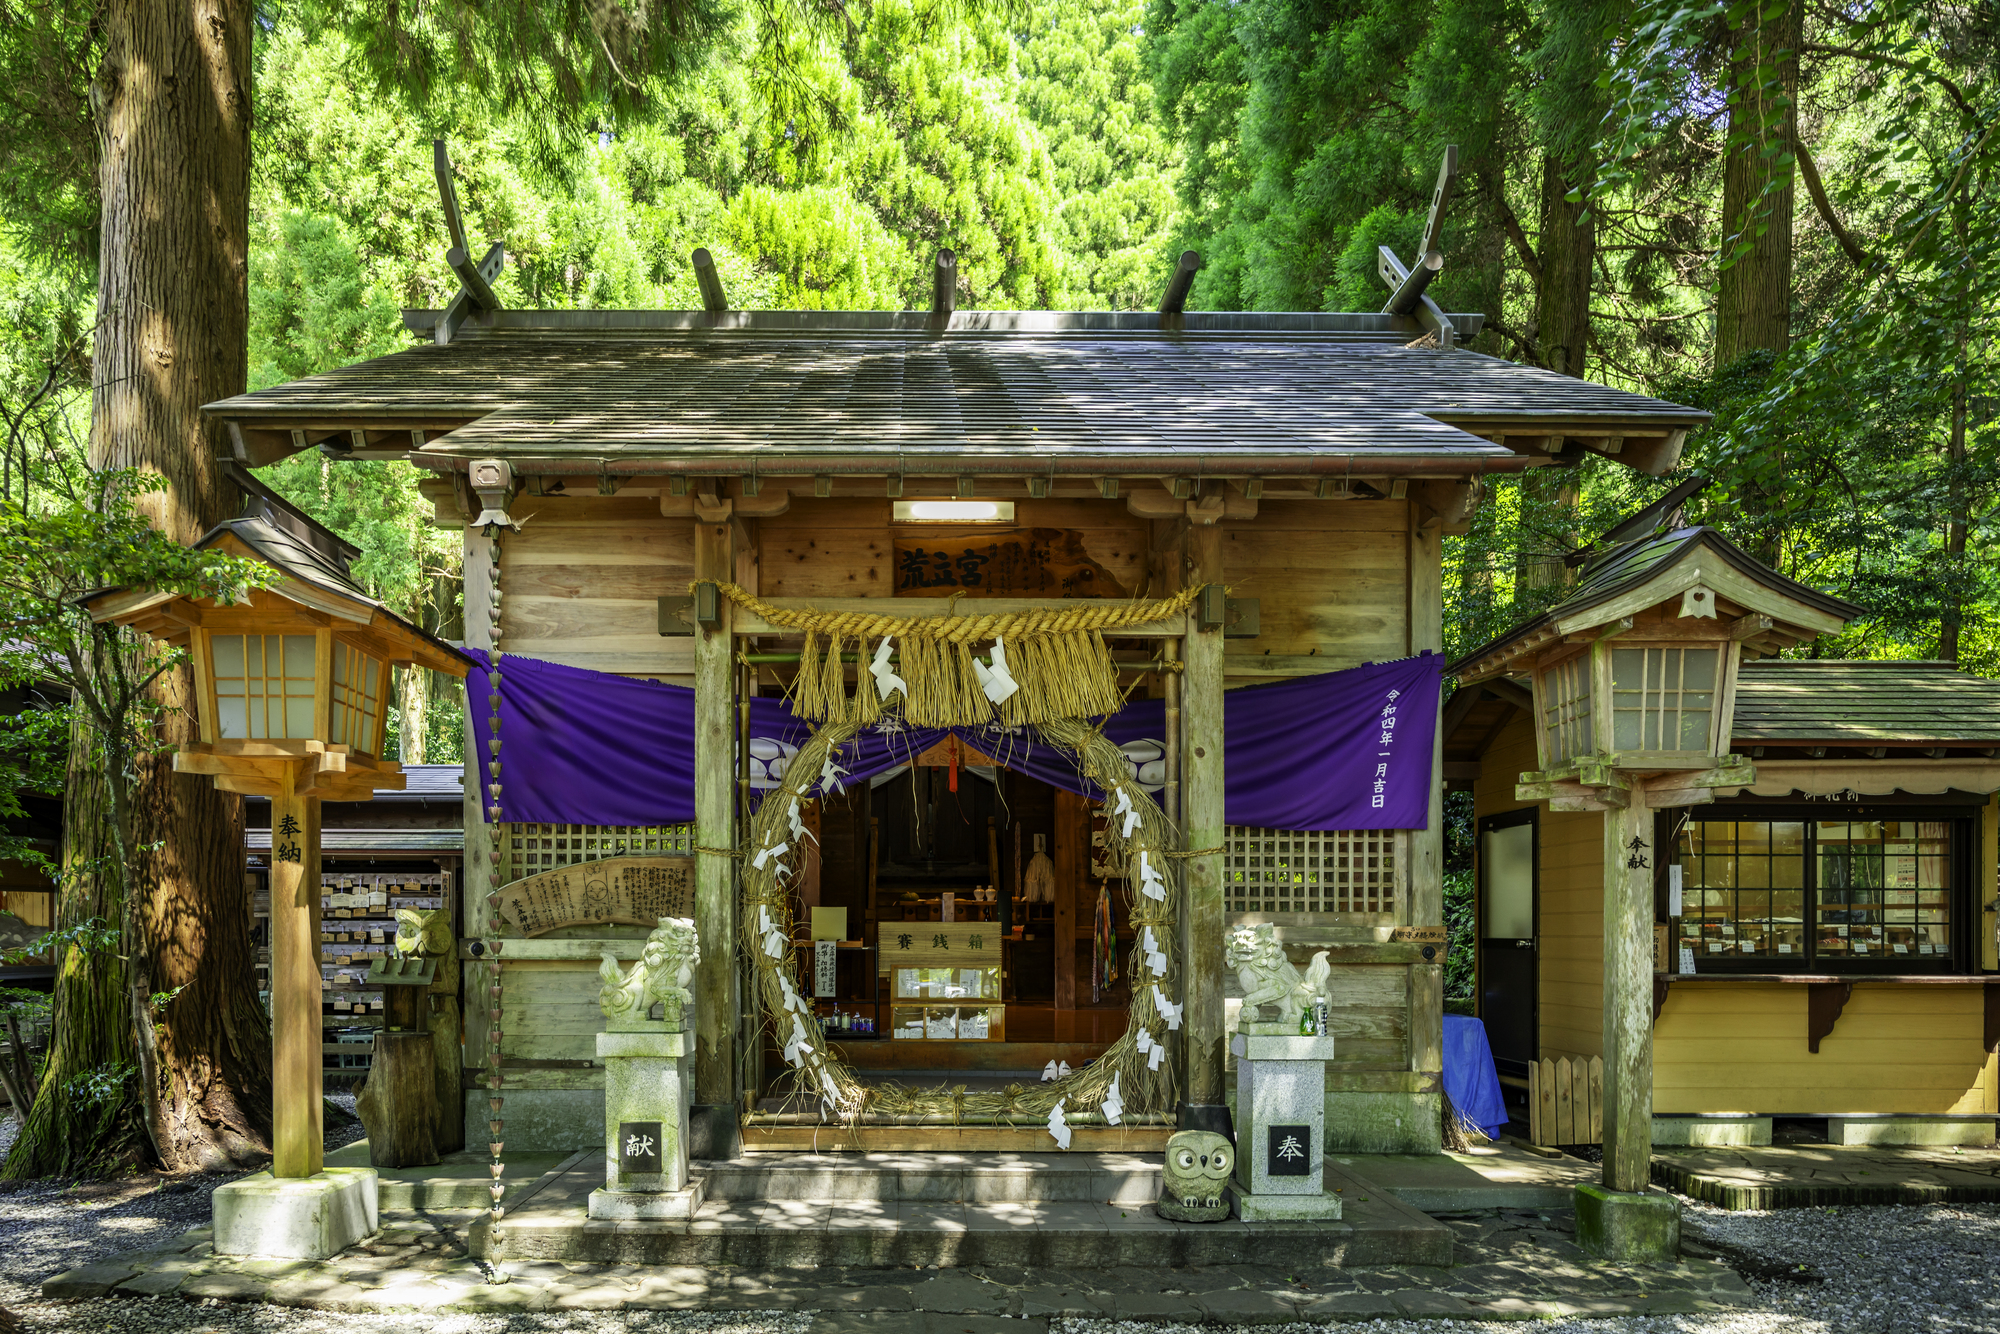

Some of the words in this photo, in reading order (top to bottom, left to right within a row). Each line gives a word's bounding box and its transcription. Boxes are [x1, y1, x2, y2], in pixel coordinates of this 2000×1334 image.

[1371, 689, 1401, 808] 令和四年一月吉日
[278, 814, 302, 864] 奉納
[1627, 836, 1650, 870] 奉献
[897, 933, 983, 950] 賽銭箱
[626, 1134, 655, 1157] 献
[1276, 1135, 1304, 1162] 奉
